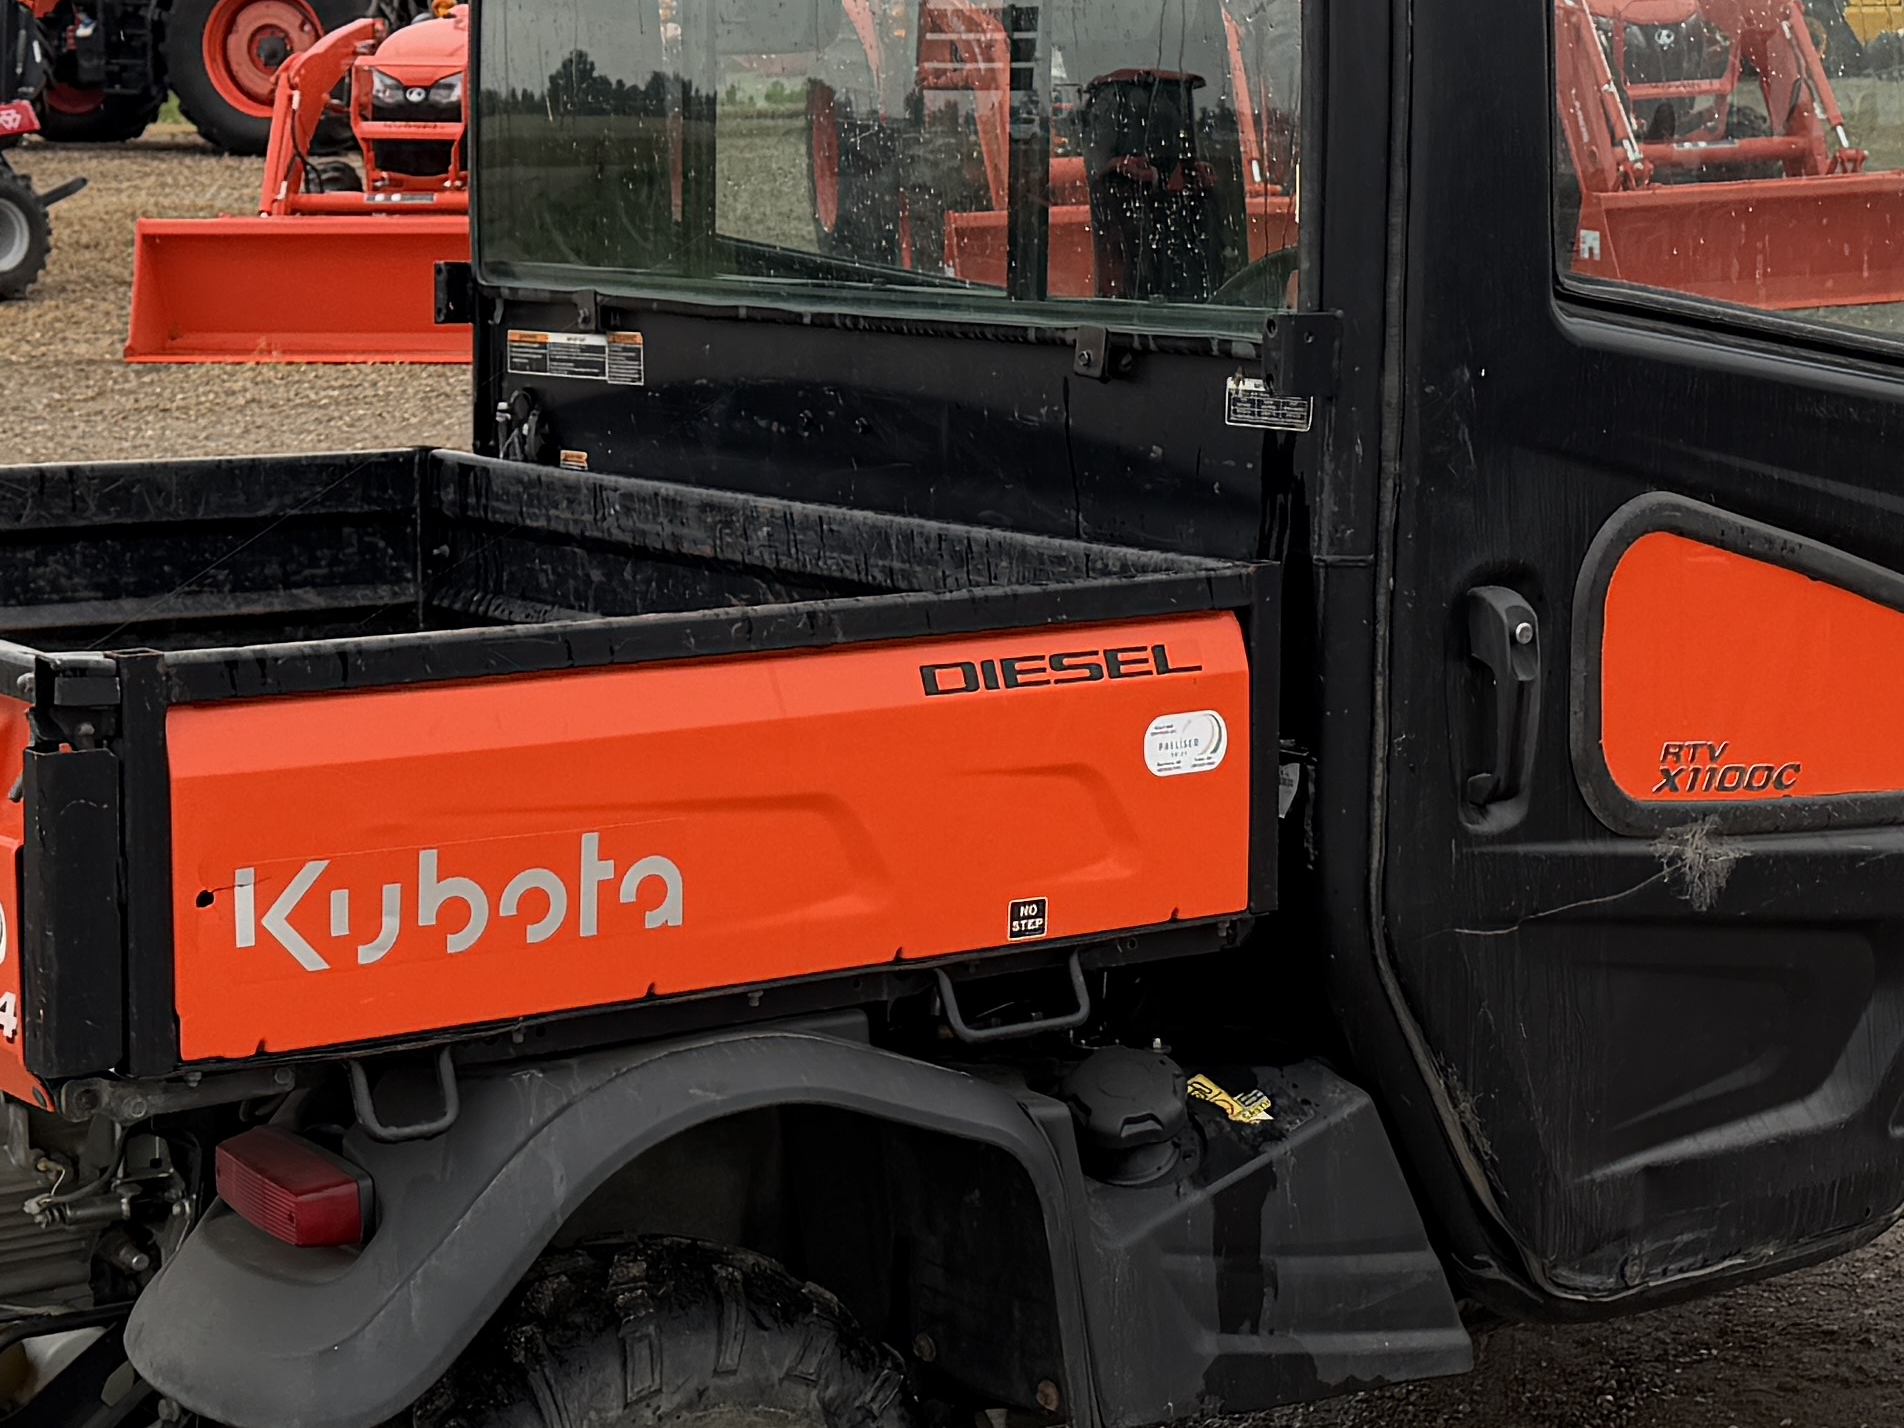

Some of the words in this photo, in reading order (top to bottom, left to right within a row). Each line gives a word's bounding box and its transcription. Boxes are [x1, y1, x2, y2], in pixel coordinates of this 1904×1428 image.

[919, 643, 1203, 697] DIESEL
[1660, 740, 1730, 763] RTV
[1652, 762, 1802, 794] X1100C
[233, 832, 684, 972] Kubota
[1019, 903, 1038, 917] NO
[1011, 917, 1044, 932] STEP
